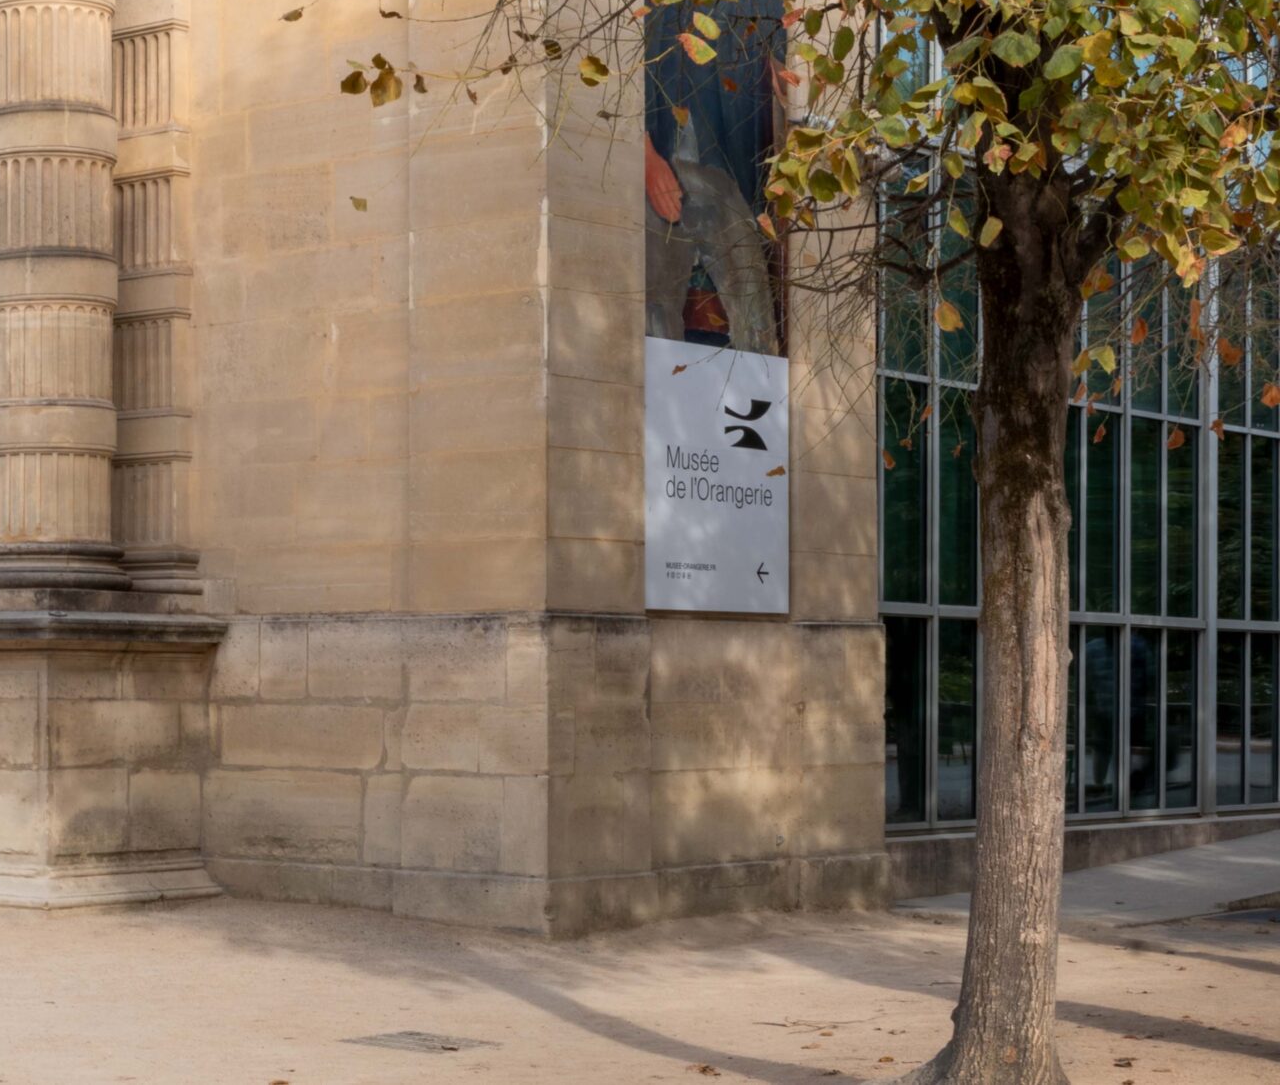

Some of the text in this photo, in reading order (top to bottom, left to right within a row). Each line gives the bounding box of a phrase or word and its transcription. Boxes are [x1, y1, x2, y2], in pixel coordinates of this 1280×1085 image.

[666, 444, 720, 473] Musée
[665, 475, 773, 509] de l'Orangerie
